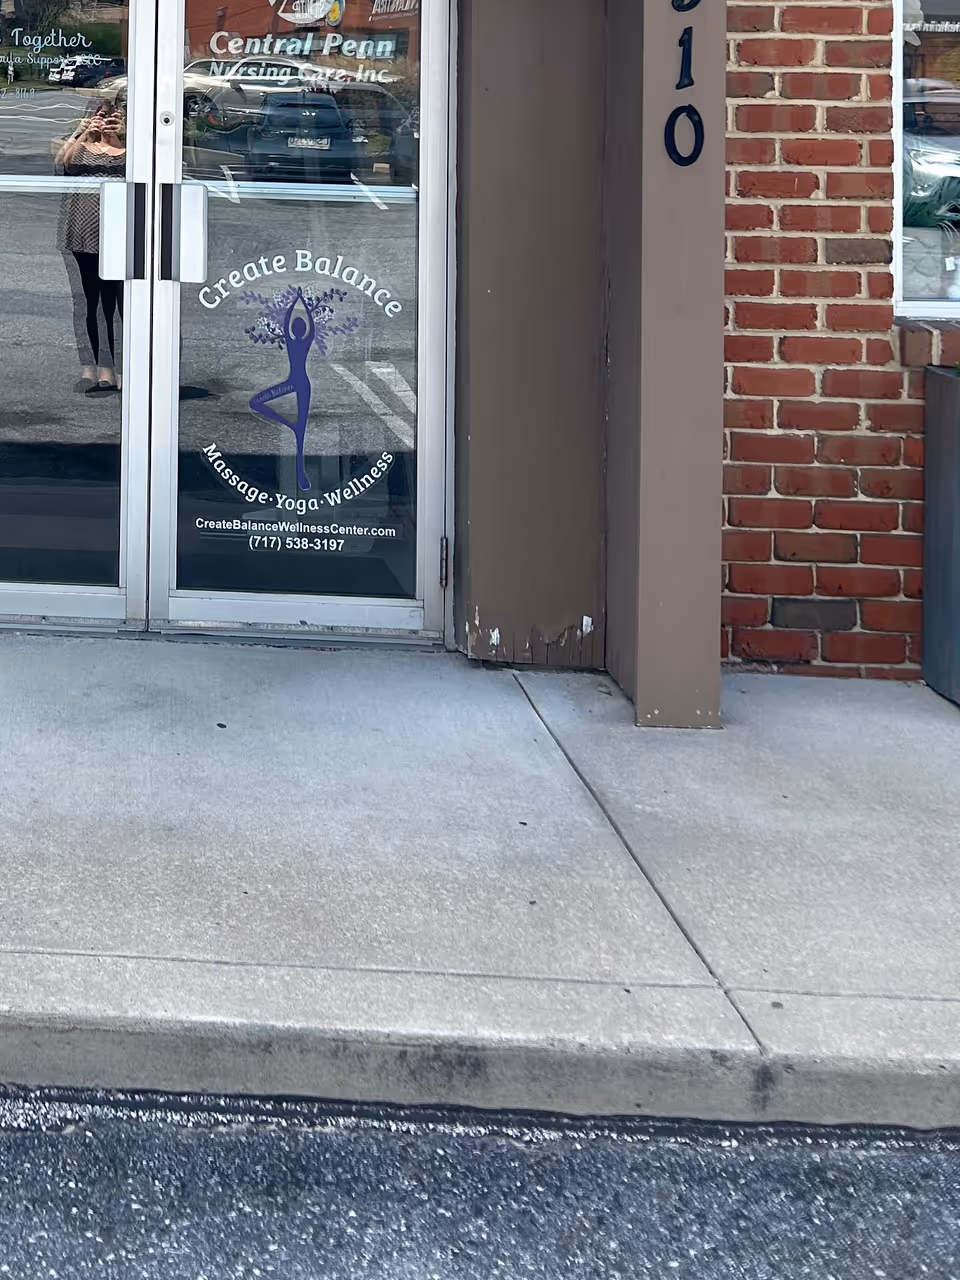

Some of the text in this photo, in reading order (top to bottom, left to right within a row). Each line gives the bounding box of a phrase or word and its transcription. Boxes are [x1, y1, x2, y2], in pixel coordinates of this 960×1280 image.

[11, 28, 92, 54] Together
[210, 31, 395, 59] Central Penn
[209, 61, 292, 86] Nursing
[198, 249, 403, 318] Create Balance
[195, 518, 396, 537] CreateBalanceWellnessCenter.com
[249, 535, 345, 552] (717) 538-3197
